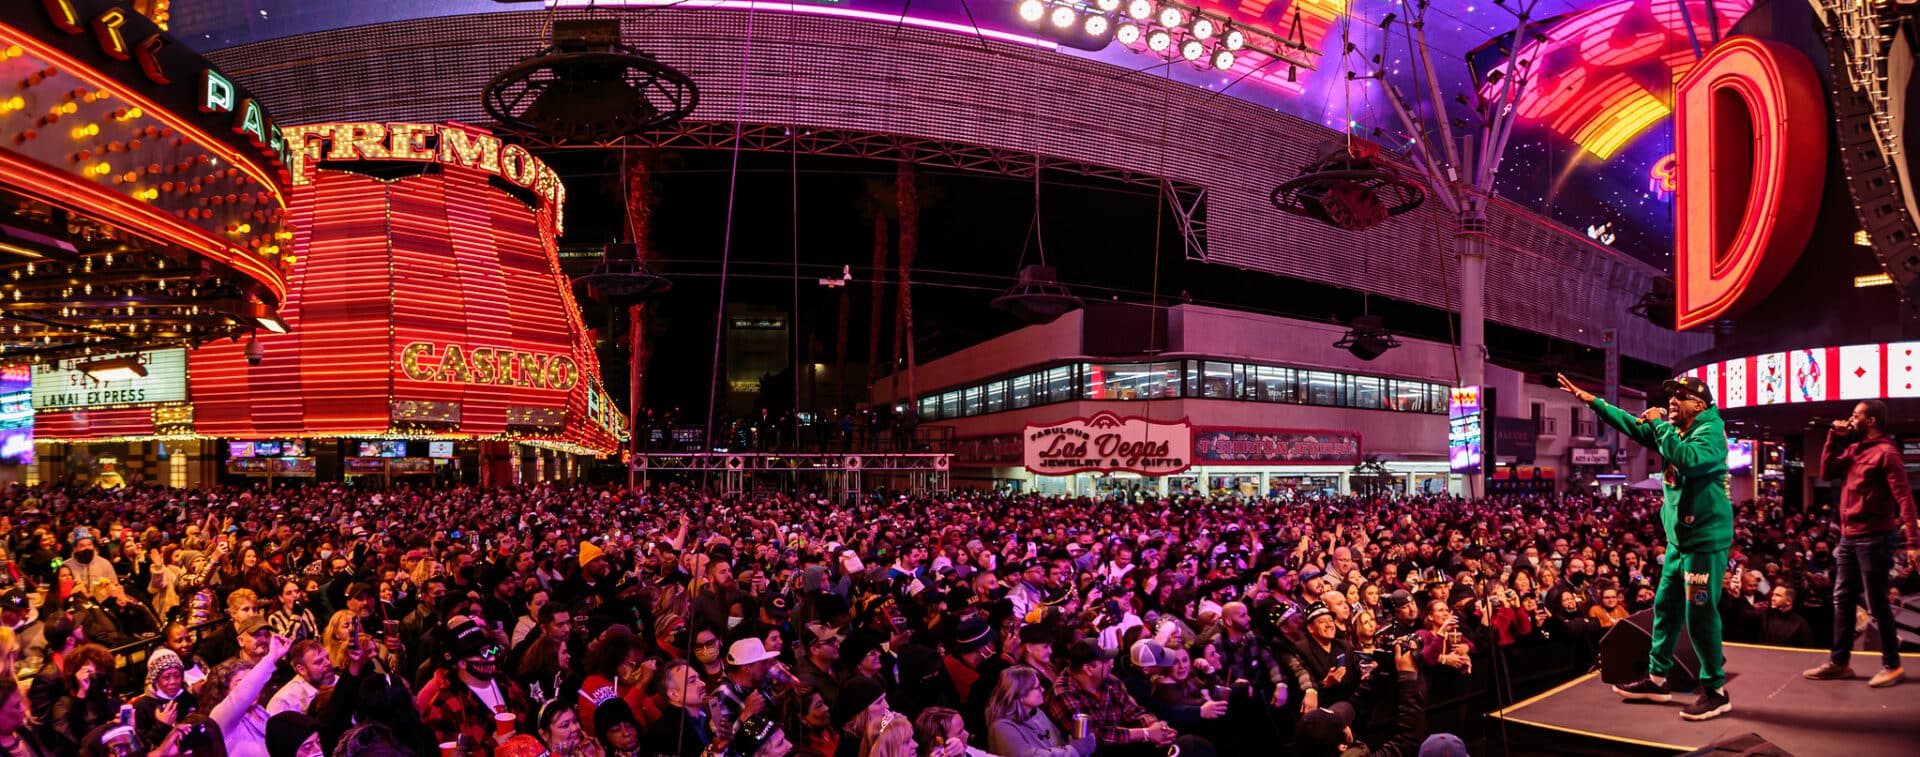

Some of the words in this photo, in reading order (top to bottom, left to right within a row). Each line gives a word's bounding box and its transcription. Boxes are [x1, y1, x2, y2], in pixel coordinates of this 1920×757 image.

[283, 122, 565, 237] FREMONT
[401, 342, 578, 391] CASINO
[43, 393, 79, 406] LANAI
[87, 388, 145, 404] EXPRESS
[1030, 427, 1090, 441] FABULOUS
[1039, 434, 1087, 459] Las
[1094, 433, 1169, 468] Vegas
[1040, 458, 1103, 467] JEWELRY
[1141, 458, 1183, 467] GIFTS
